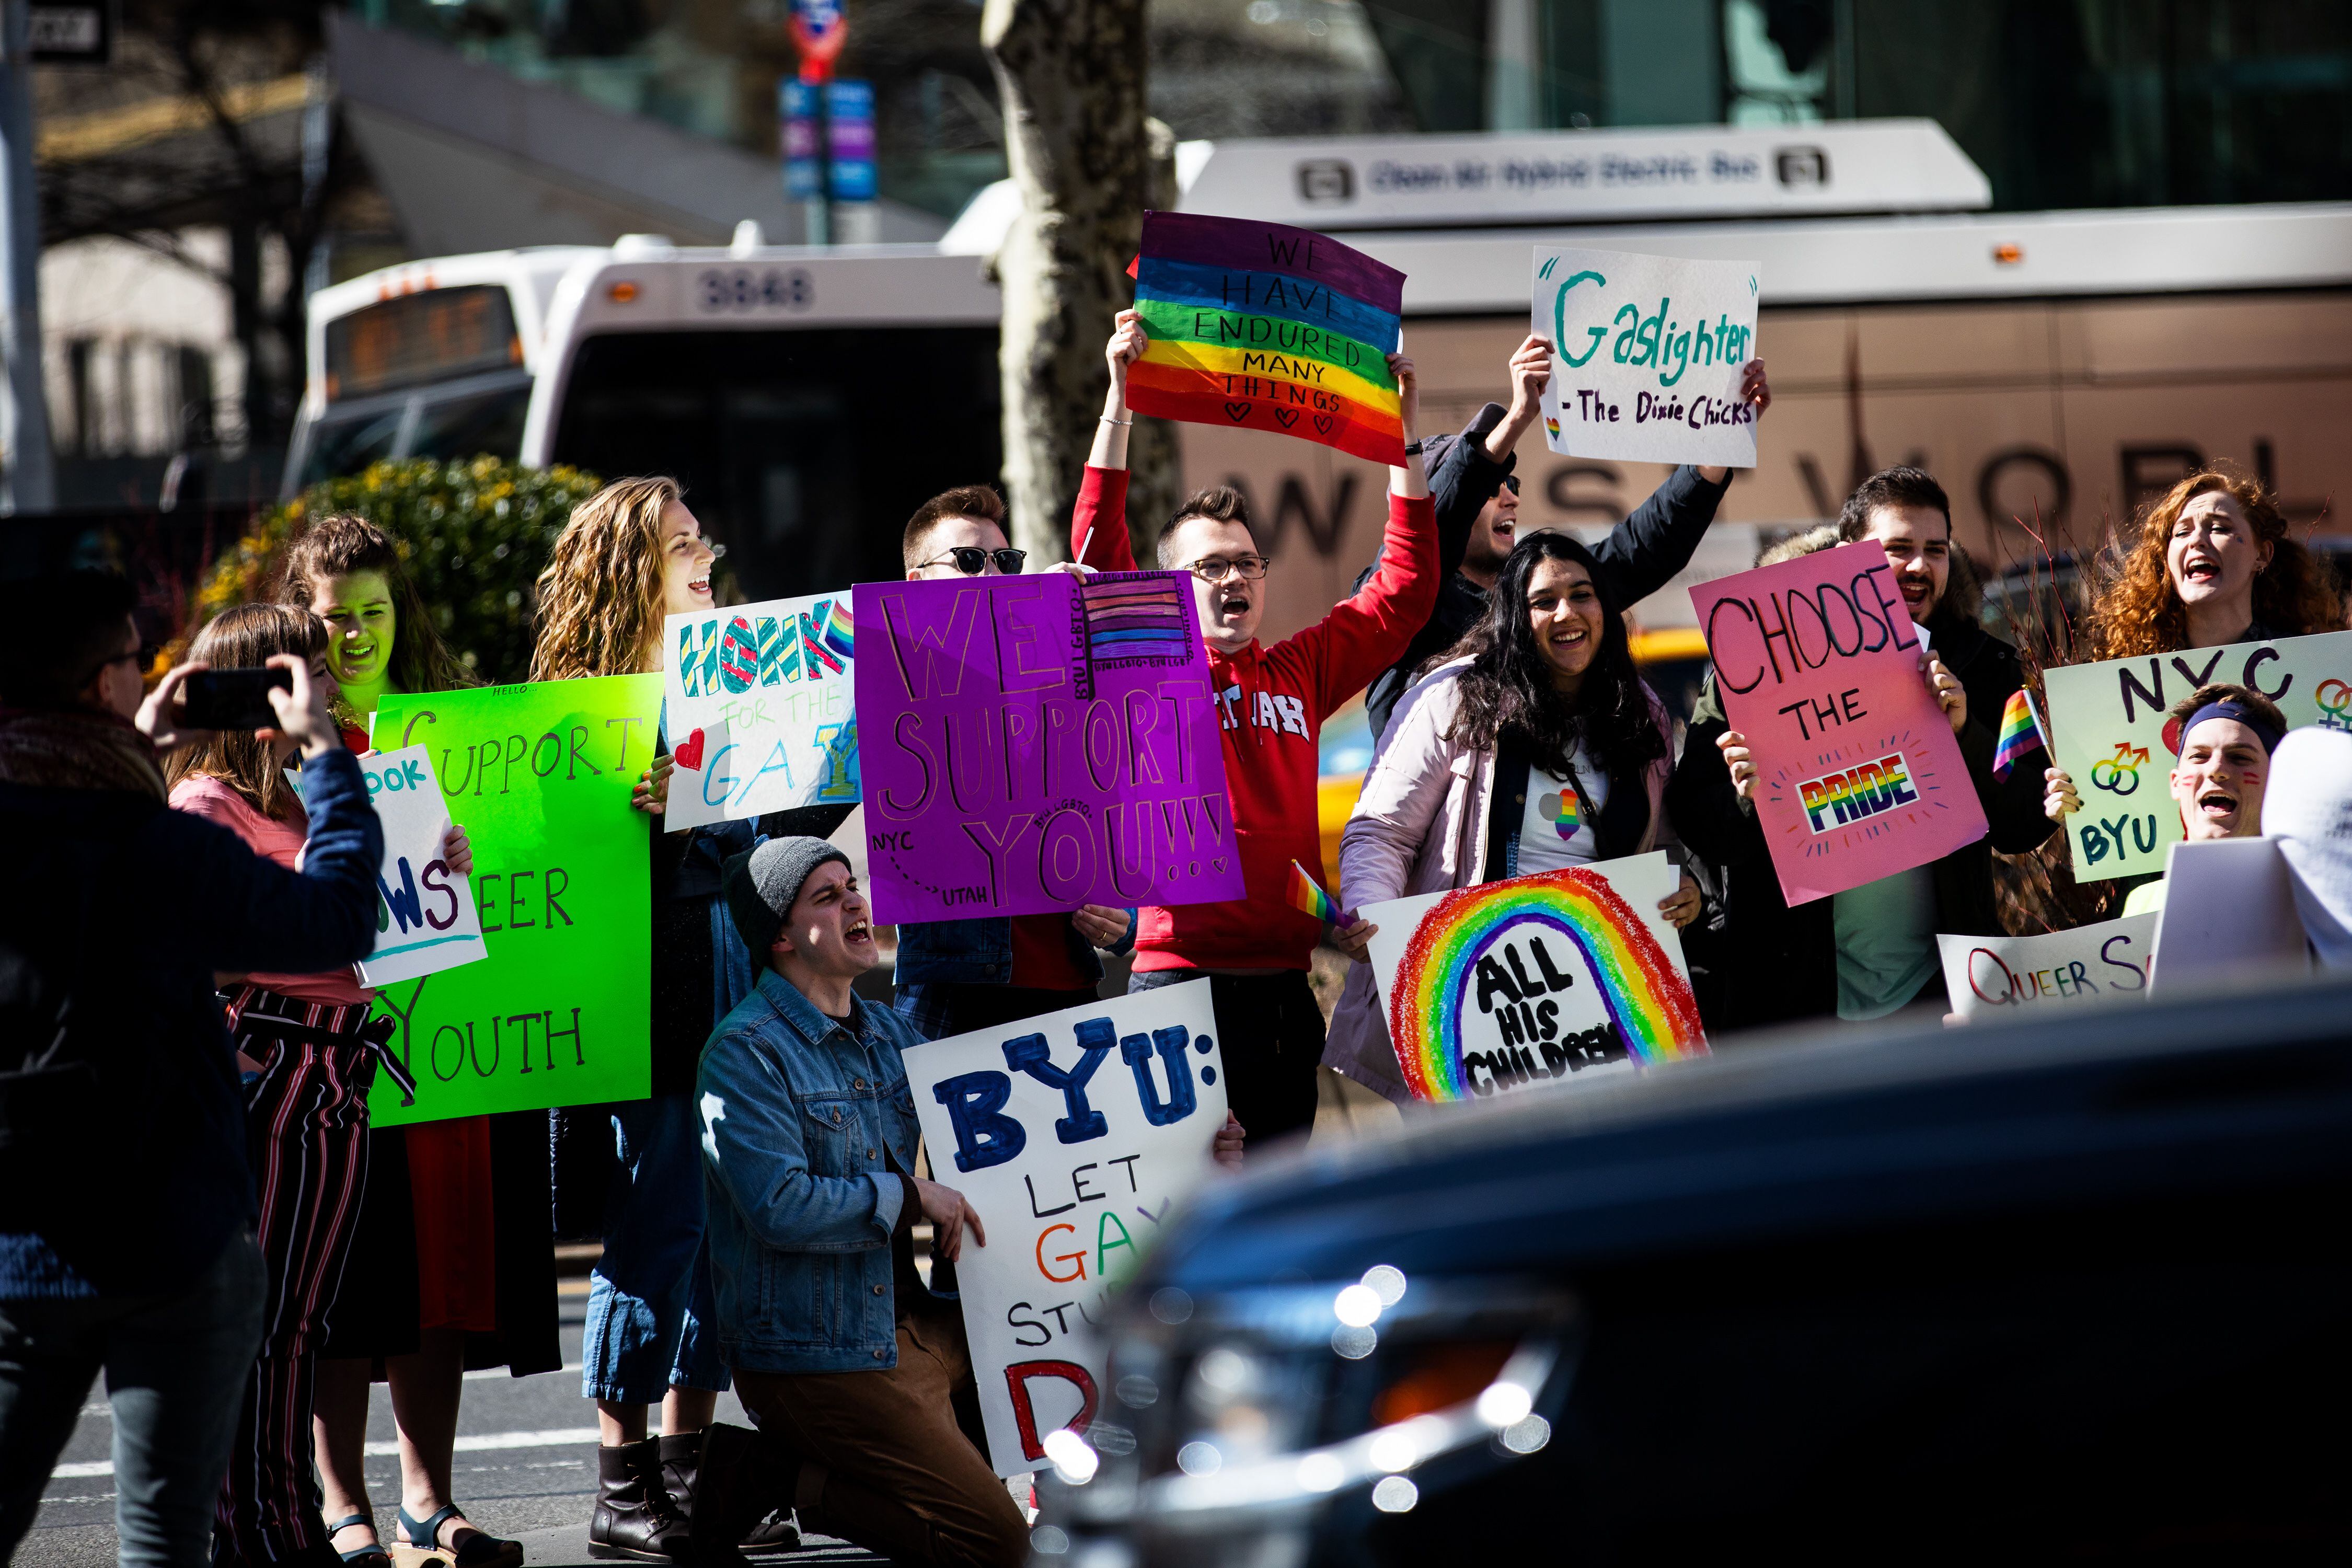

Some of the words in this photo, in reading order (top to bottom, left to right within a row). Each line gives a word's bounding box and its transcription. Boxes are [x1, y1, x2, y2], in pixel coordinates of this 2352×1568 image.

[1267, 233, 1323, 274] WE
[1221, 274, 1342, 322] HAVE
[1195, 312, 1359, 367] ENDURED
[1243, 352, 1325, 383] MANY
[1221, 374, 1340, 412] THINGS
[1636, 390, 1683, 423] Dixie
[1689, 395, 1753, 430] Chicks
[680, 599, 846, 697] HONK
[879, 581, 1065, 702] WE
[1708, 563, 1919, 694] CHOOSE
[718, 697, 776, 734] FOR
[784, 684, 842, 723] THE
[1074, 666, 1088, 700] BYU
[2119, 647, 2293, 723] NYC
[1213, 684, 1310, 744] TAH
[1778, 687, 1867, 741] THE
[703, 720, 860, 808] GAY
[877, 680, 1206, 821] SUPPORT
[1800, 754, 1917, 832] PRIDE
[872, 831, 915, 852] NYC
[2080, 813, 2157, 866] BYU
[942, 886, 988, 906] UTAH
[1477, 936, 1573, 1013] ALL
[1968, 947, 2100, 1007] QUEER
[375, 973, 585, 1107] YOUTH
[1494, 999, 1559, 1047] HIS
[1463, 1022, 1631, 1097] CHILDREN
[933, 1017, 1217, 1173] BYU:
[1024, 1154, 1141, 1219] LET
